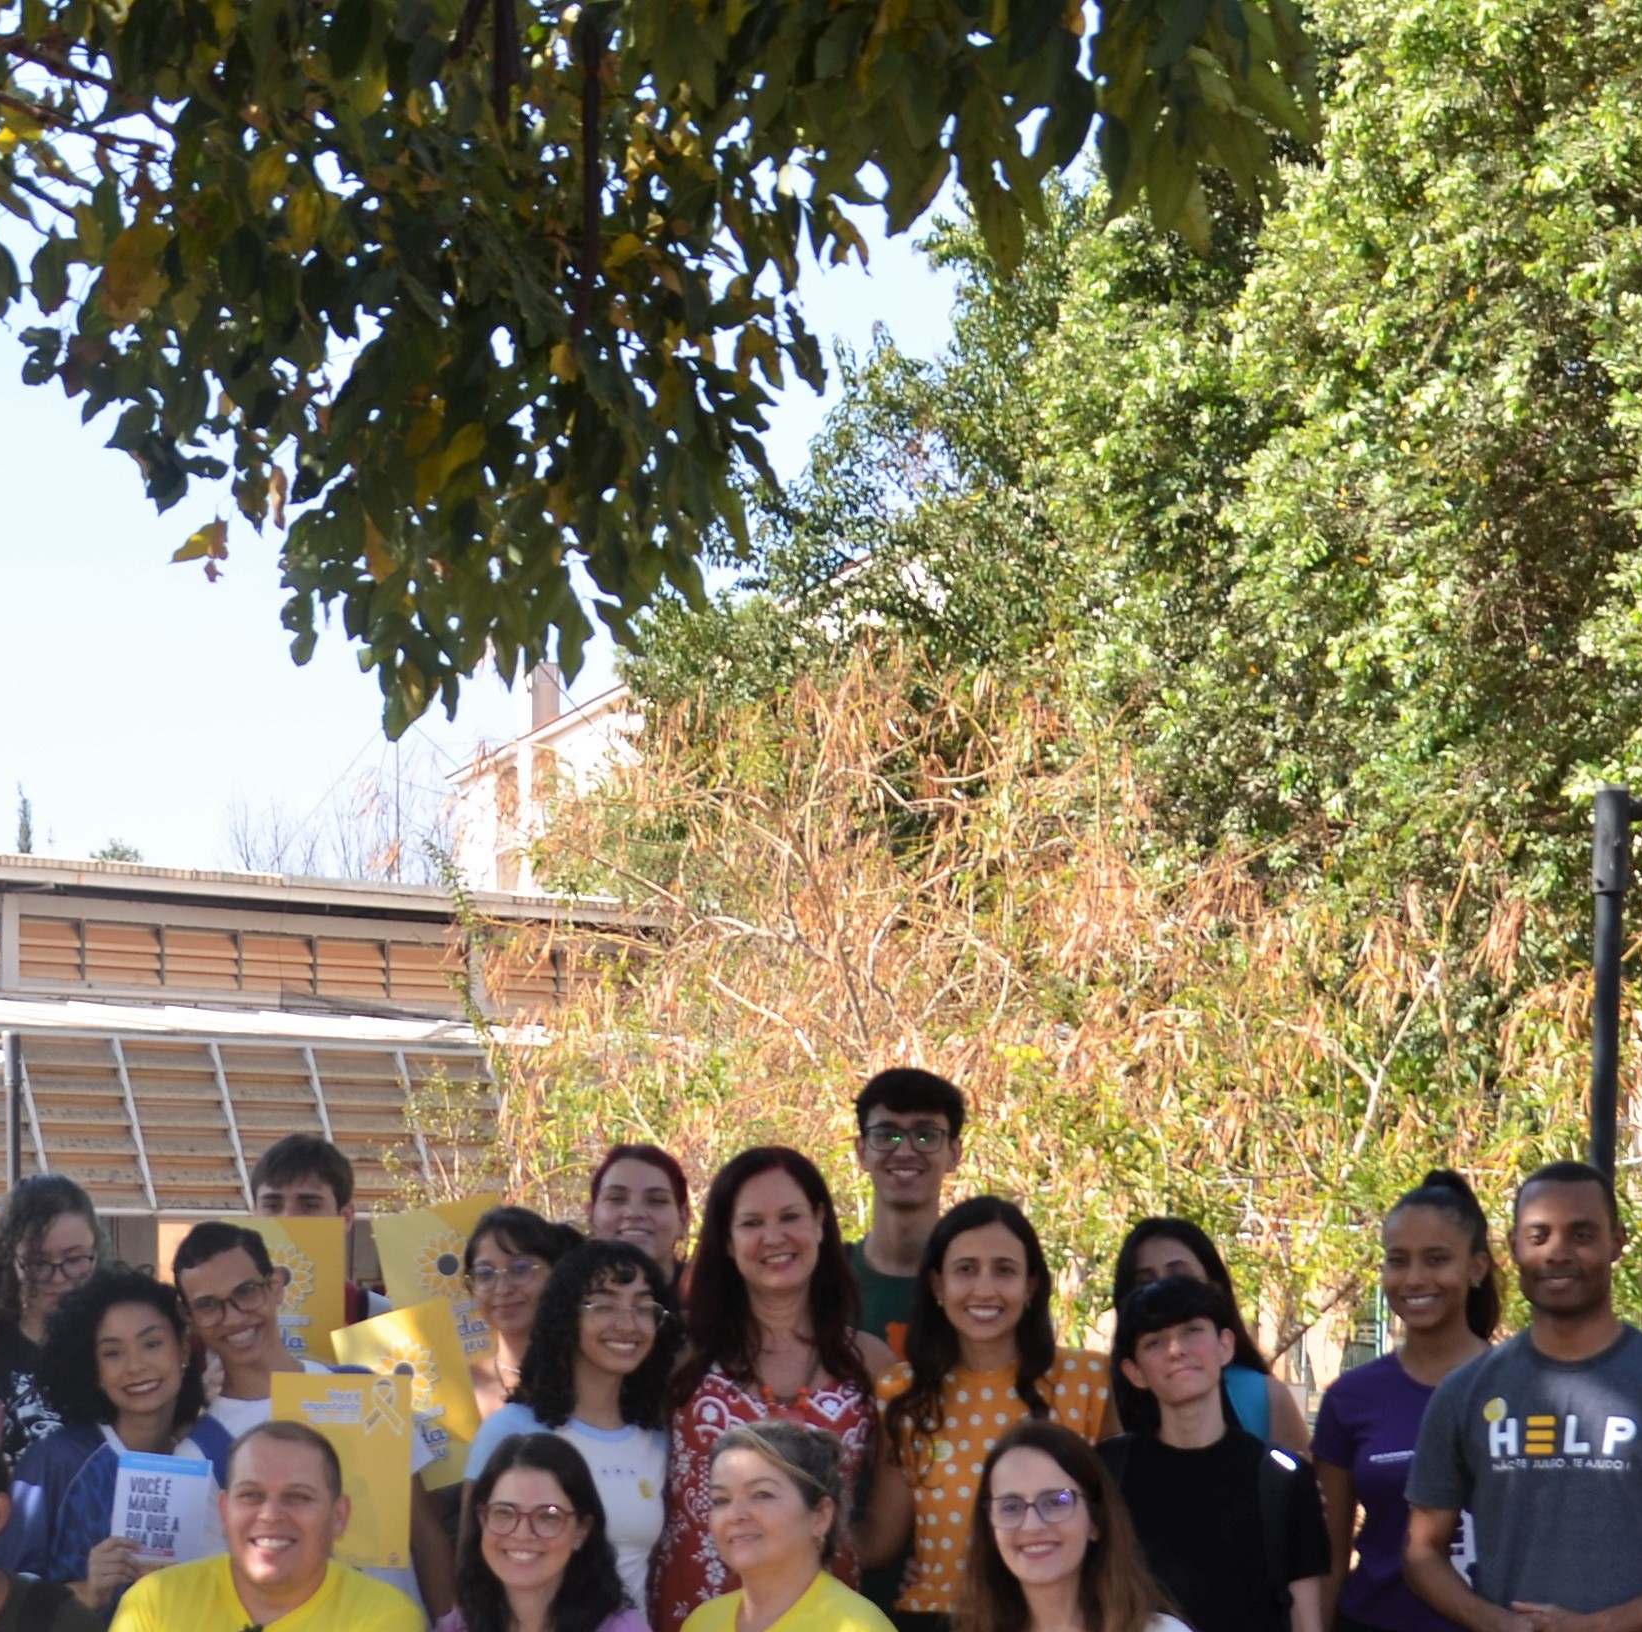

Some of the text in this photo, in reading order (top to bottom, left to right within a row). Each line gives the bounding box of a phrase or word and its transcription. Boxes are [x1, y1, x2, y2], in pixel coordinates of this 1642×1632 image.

[1489, 1414, 1637, 1458] HELP
[128, 1494, 168, 1513] MAIOR
[126, 1512, 179, 1532] DO QUE A
